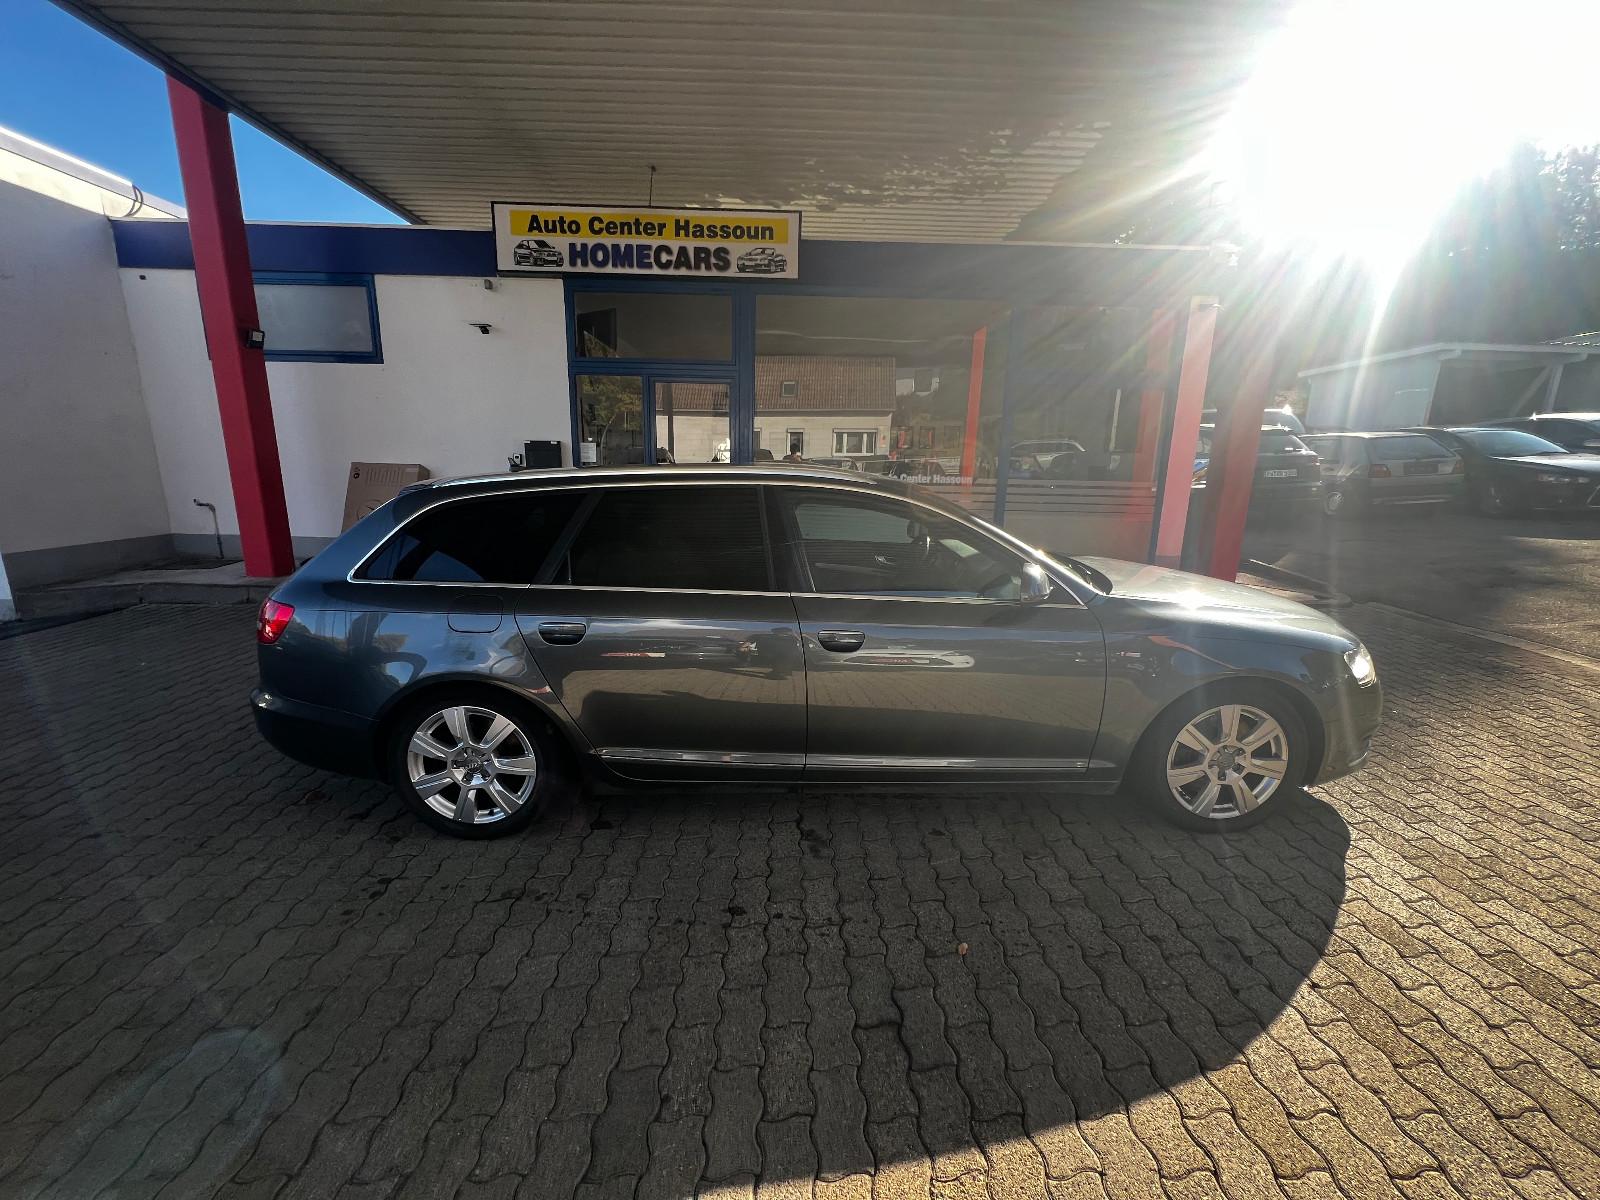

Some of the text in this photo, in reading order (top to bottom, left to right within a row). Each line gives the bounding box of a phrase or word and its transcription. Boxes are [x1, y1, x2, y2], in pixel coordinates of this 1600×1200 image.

[528, 214, 774, 240] Auto Center Hassoun
[568, 243, 731, 270] HOMECARS
[900, 473, 931, 483] Center
[933, 474, 973, 485] Hassoun
